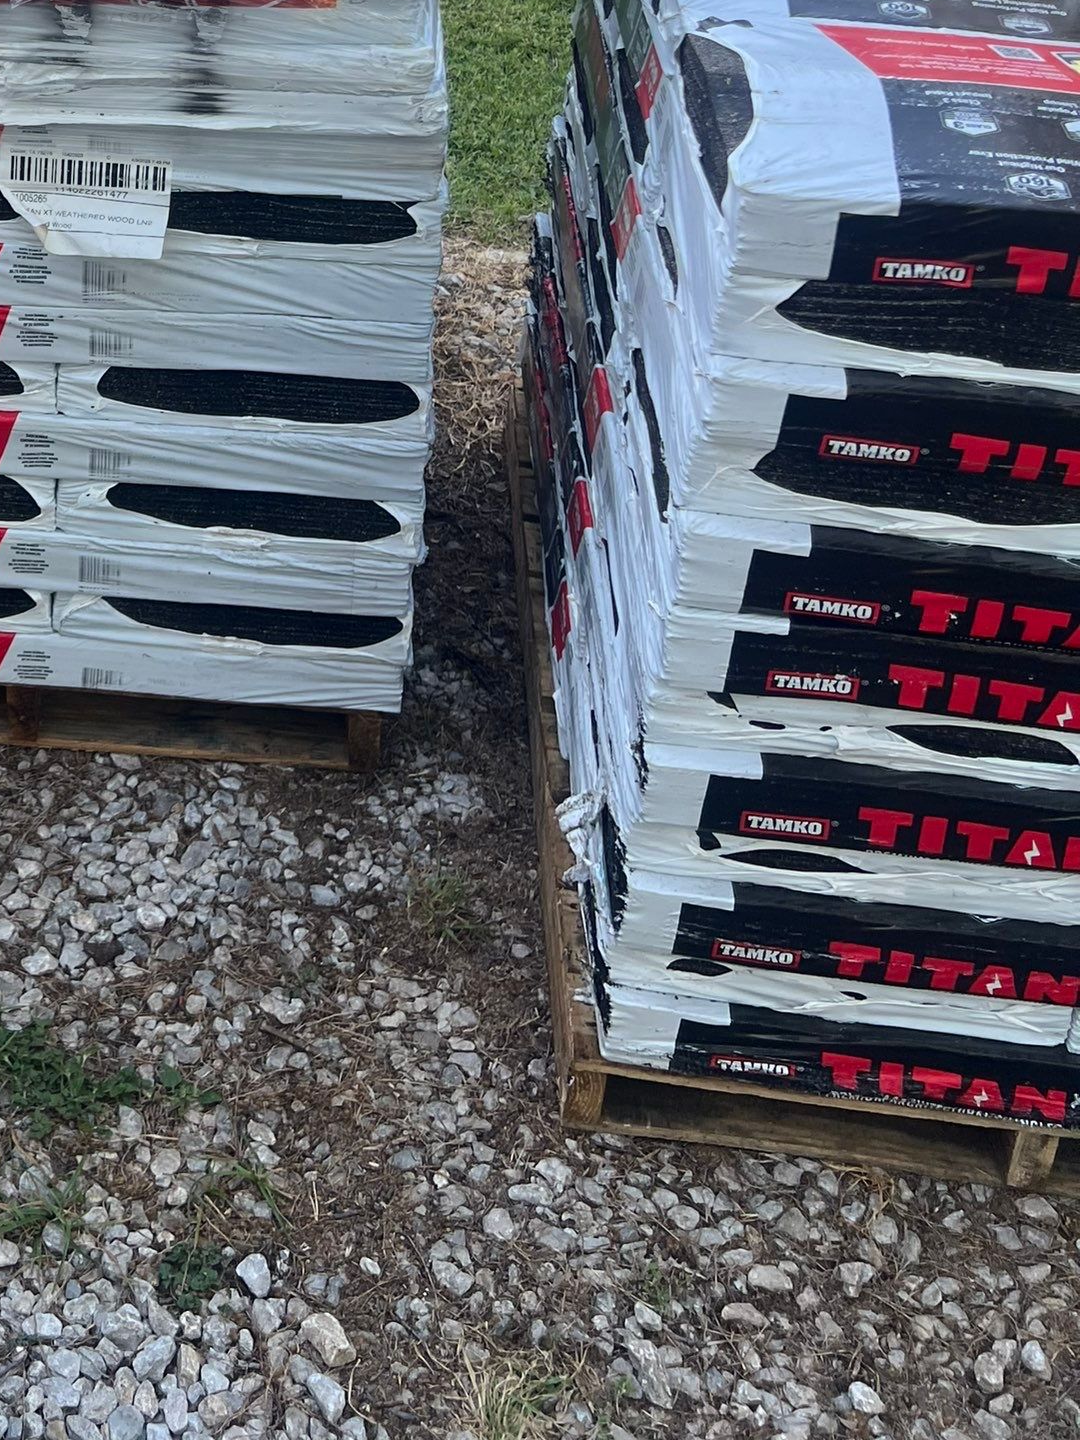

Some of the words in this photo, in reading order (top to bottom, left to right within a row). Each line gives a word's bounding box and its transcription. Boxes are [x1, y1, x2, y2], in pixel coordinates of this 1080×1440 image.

[1019, 176, 1054, 187] 160
[52, 221, 72, 229] Wood
[54, 210, 106, 222] WEATHERED
[107, 216, 135, 225] WOOD
[881, 261, 965, 283] TAMKO
[828, 439, 911, 462] TAMKO
[791, 595, 874, 620] TAMKO
[773, 673, 852, 695] TAMKO
[747, 816, 822, 836] TAMKO
[719, 942, 794, 966] TAMKO
[828, 941, 1080, 1007] TITAN
[717, 1058, 790, 1077] TAMKO
[821, 1051, 1068, 1121] TITAN
